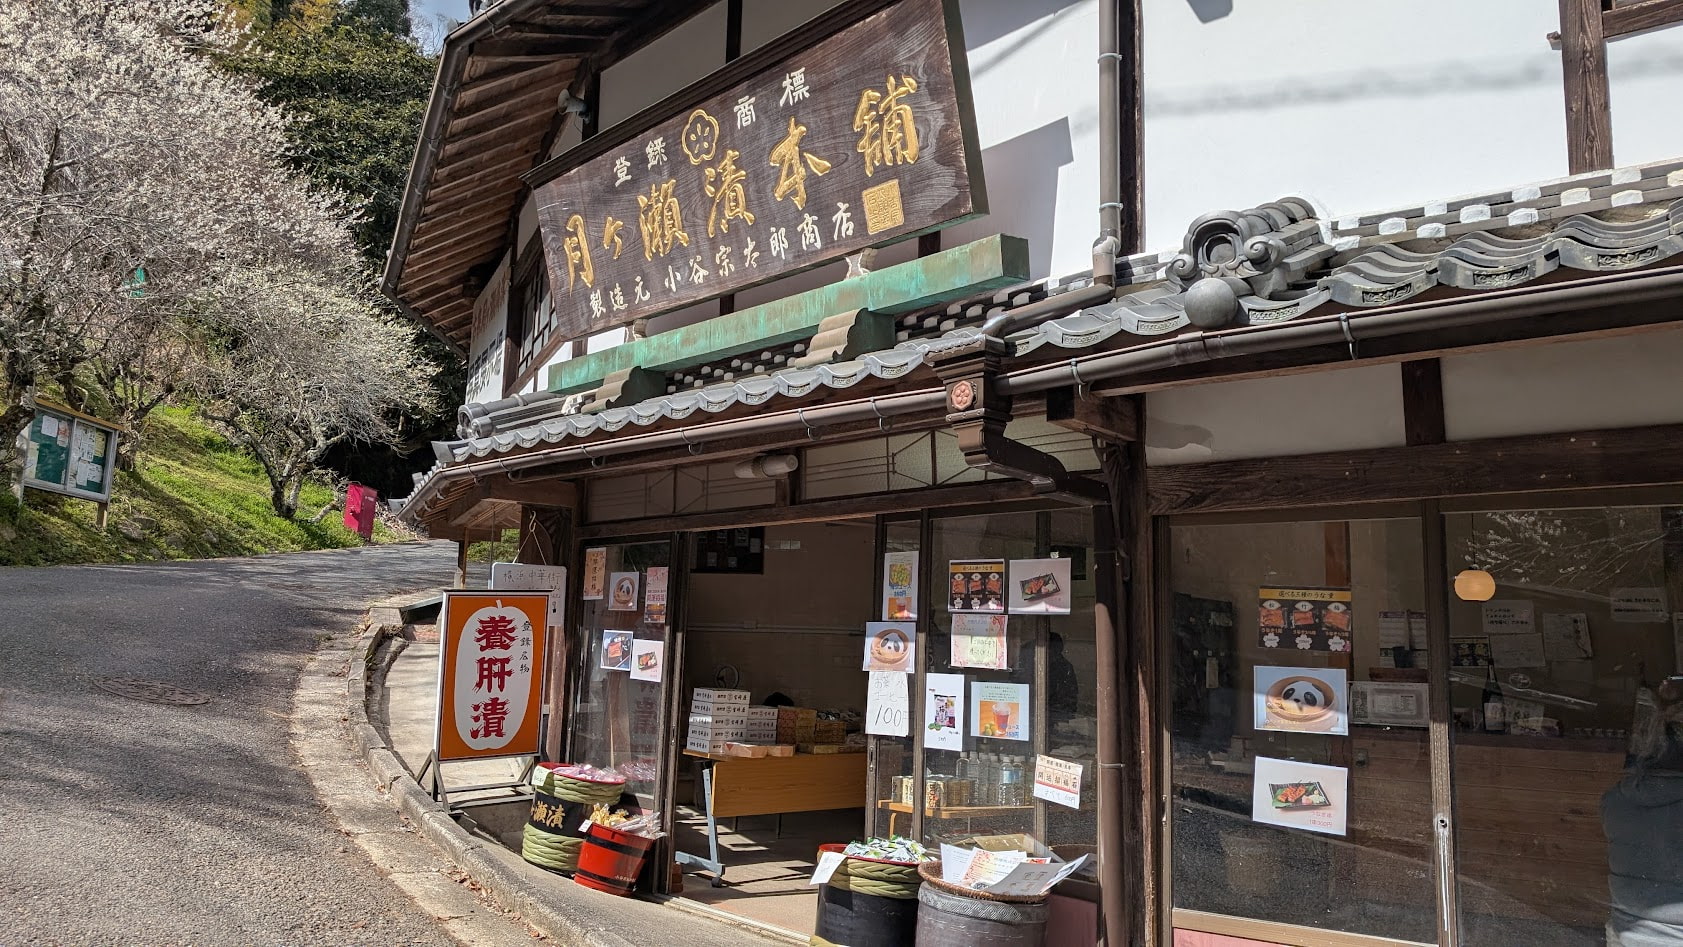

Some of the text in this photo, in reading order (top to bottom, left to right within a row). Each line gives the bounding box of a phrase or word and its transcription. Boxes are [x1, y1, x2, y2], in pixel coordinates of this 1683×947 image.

[589, 276, 651, 319] 製造元
[470, 614, 518, 739] 養肝漬
